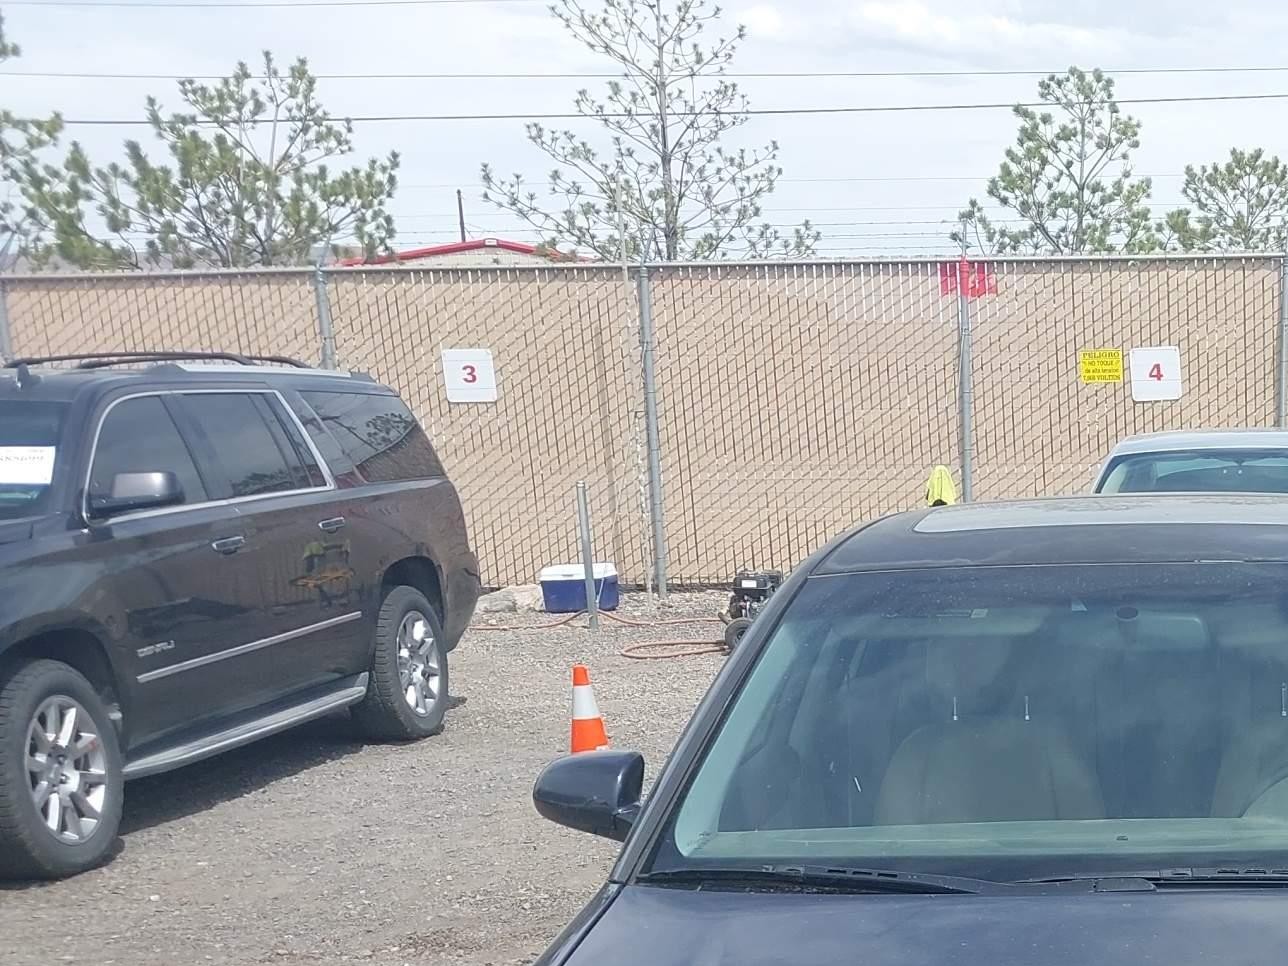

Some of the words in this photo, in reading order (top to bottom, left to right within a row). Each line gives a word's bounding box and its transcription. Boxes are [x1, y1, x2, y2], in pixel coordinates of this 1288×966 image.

[1083, 351, 1119, 359] PELIGRO
[462, 365, 477, 383] 3
[1149, 363, 1164, 381] 4
